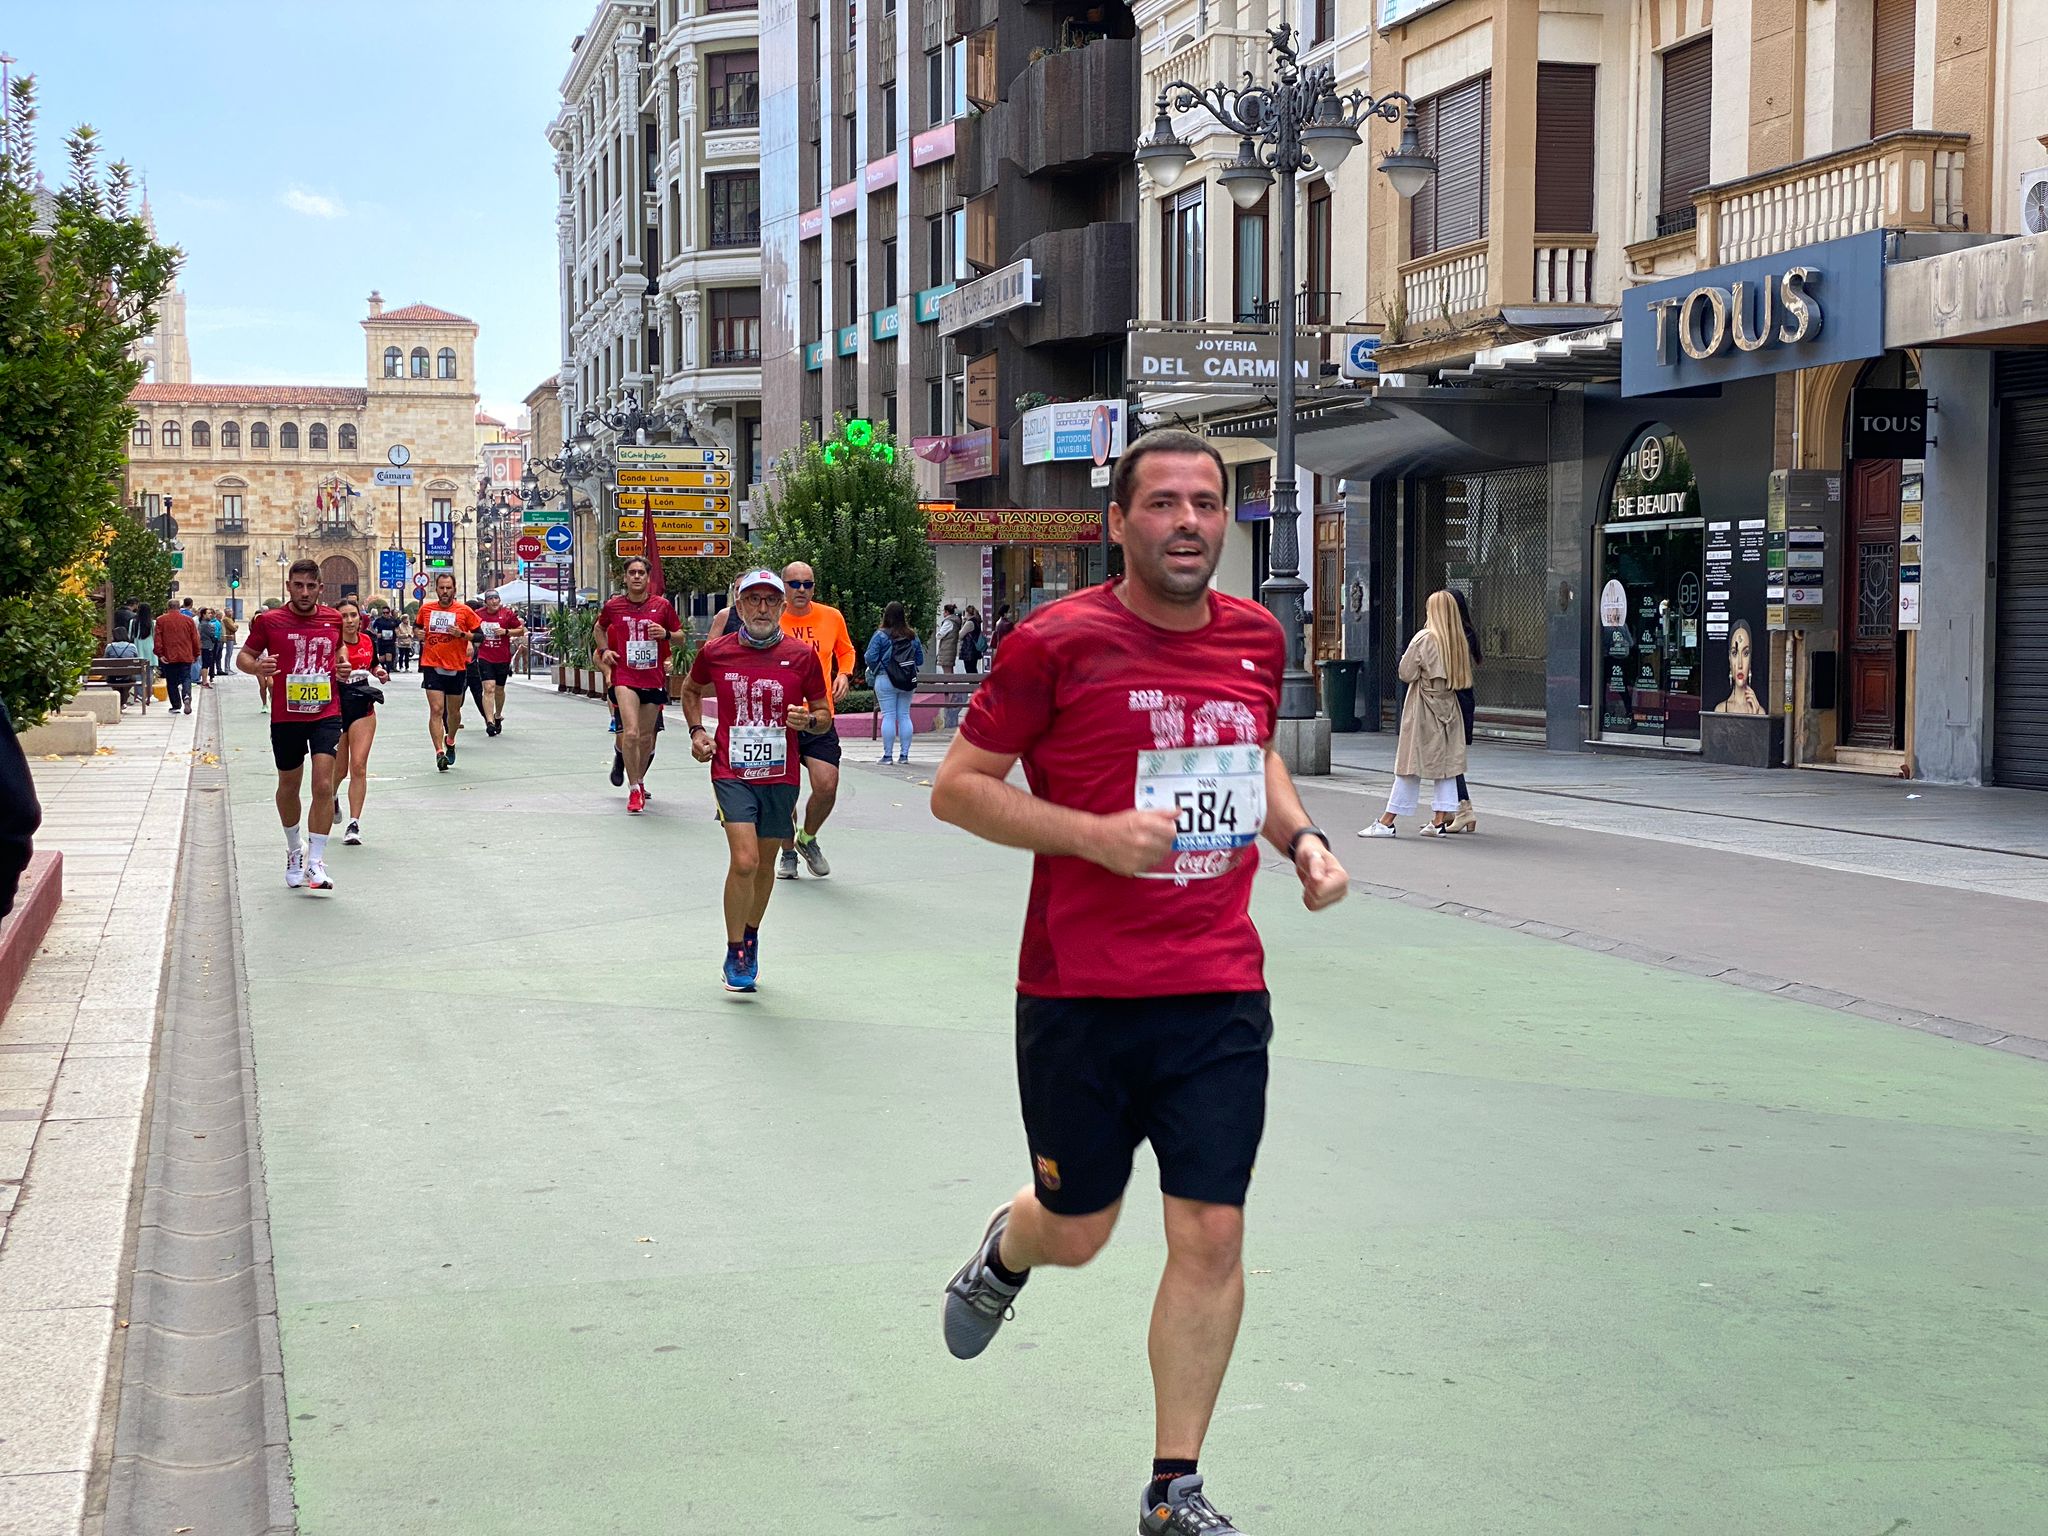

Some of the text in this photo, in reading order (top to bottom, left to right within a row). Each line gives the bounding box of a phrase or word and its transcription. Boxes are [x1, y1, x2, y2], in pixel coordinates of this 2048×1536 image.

[885, 314, 898, 331] cas
[1647, 266, 1822, 367] TOUS
[1195, 339, 1257, 352] JOYERIA
[1142, 356, 1309, 378] DEL CARMN
[1859, 415, 1921, 433] TOUS
[1056, 434, 1091, 444] ORTODONC
[1056, 444, 1087, 454] INVISIBLE
[704, 451, 713, 461] P
[1642, 448, 1658, 470] BE
[376, 471, 411, 481] Cámara
[620, 474, 669, 482] Conde Luna
[620, 497, 637, 505] Luis
[654, 498, 674, 506] León
[1618, 492, 1687, 517] BE BEAUTY
[620, 520, 638, 528] A.C.
[661, 521, 693, 529] Antonio
[932, 524, 969, 532] INDIAN
[975, 524, 1047, 533] RESTAURANT
[1058, 525, 1082, 533] BAR
[428, 522, 443, 545] P
[518, 544, 540, 552] STOP
[620, 544, 698, 552] casin onde Luna
[1680, 584, 1697, 604] BE
[792, 626, 814, 639] WE
[634, 650, 651, 660] 505
[300, 687, 319, 700] 213
[743, 743, 772, 762] 529
[1174, 790, 1237, 833] 584
